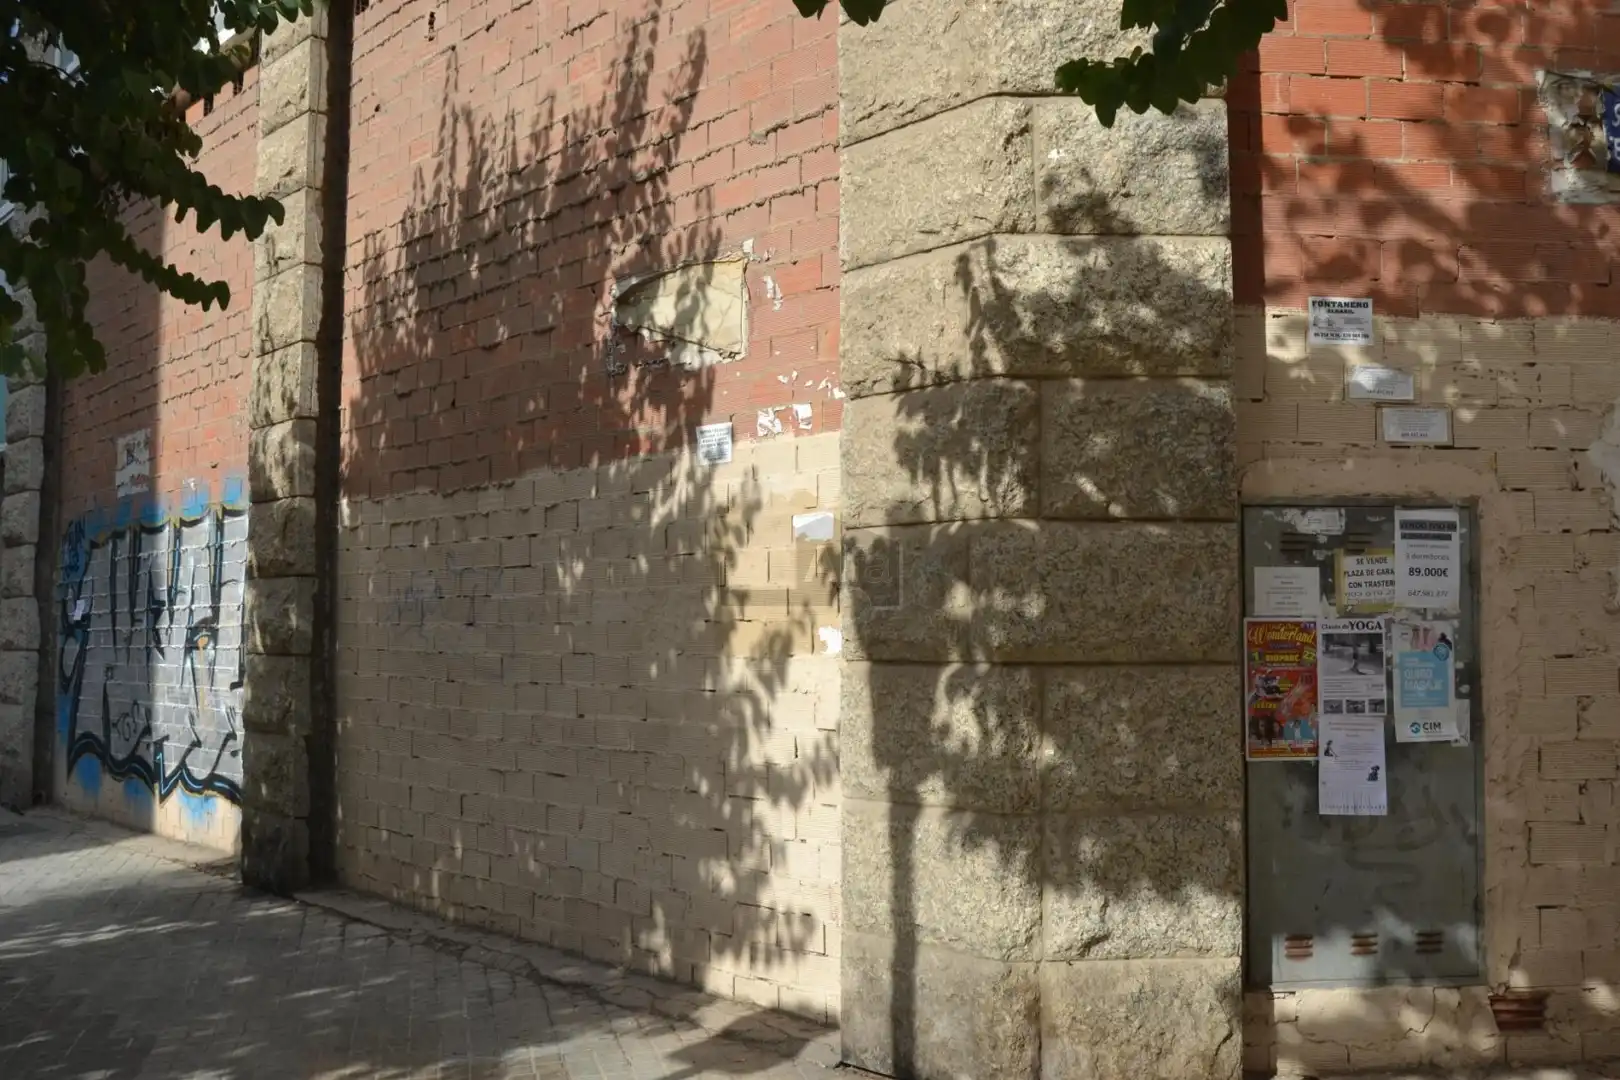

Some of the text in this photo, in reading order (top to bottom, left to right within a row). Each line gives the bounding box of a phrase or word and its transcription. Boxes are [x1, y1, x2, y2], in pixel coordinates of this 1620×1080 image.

[1366, 556, 1388, 565] VENDE
[1366, 568, 1375, 577] DE
[1408, 567, 1449, 577] 89.000€
[1364, 579, 1396, 588] TRASTER
[1348, 620, 1383, 631] YOGA
[1404, 680, 1444, 691] MASAJE
[1422, 722, 1442, 731] CIM
